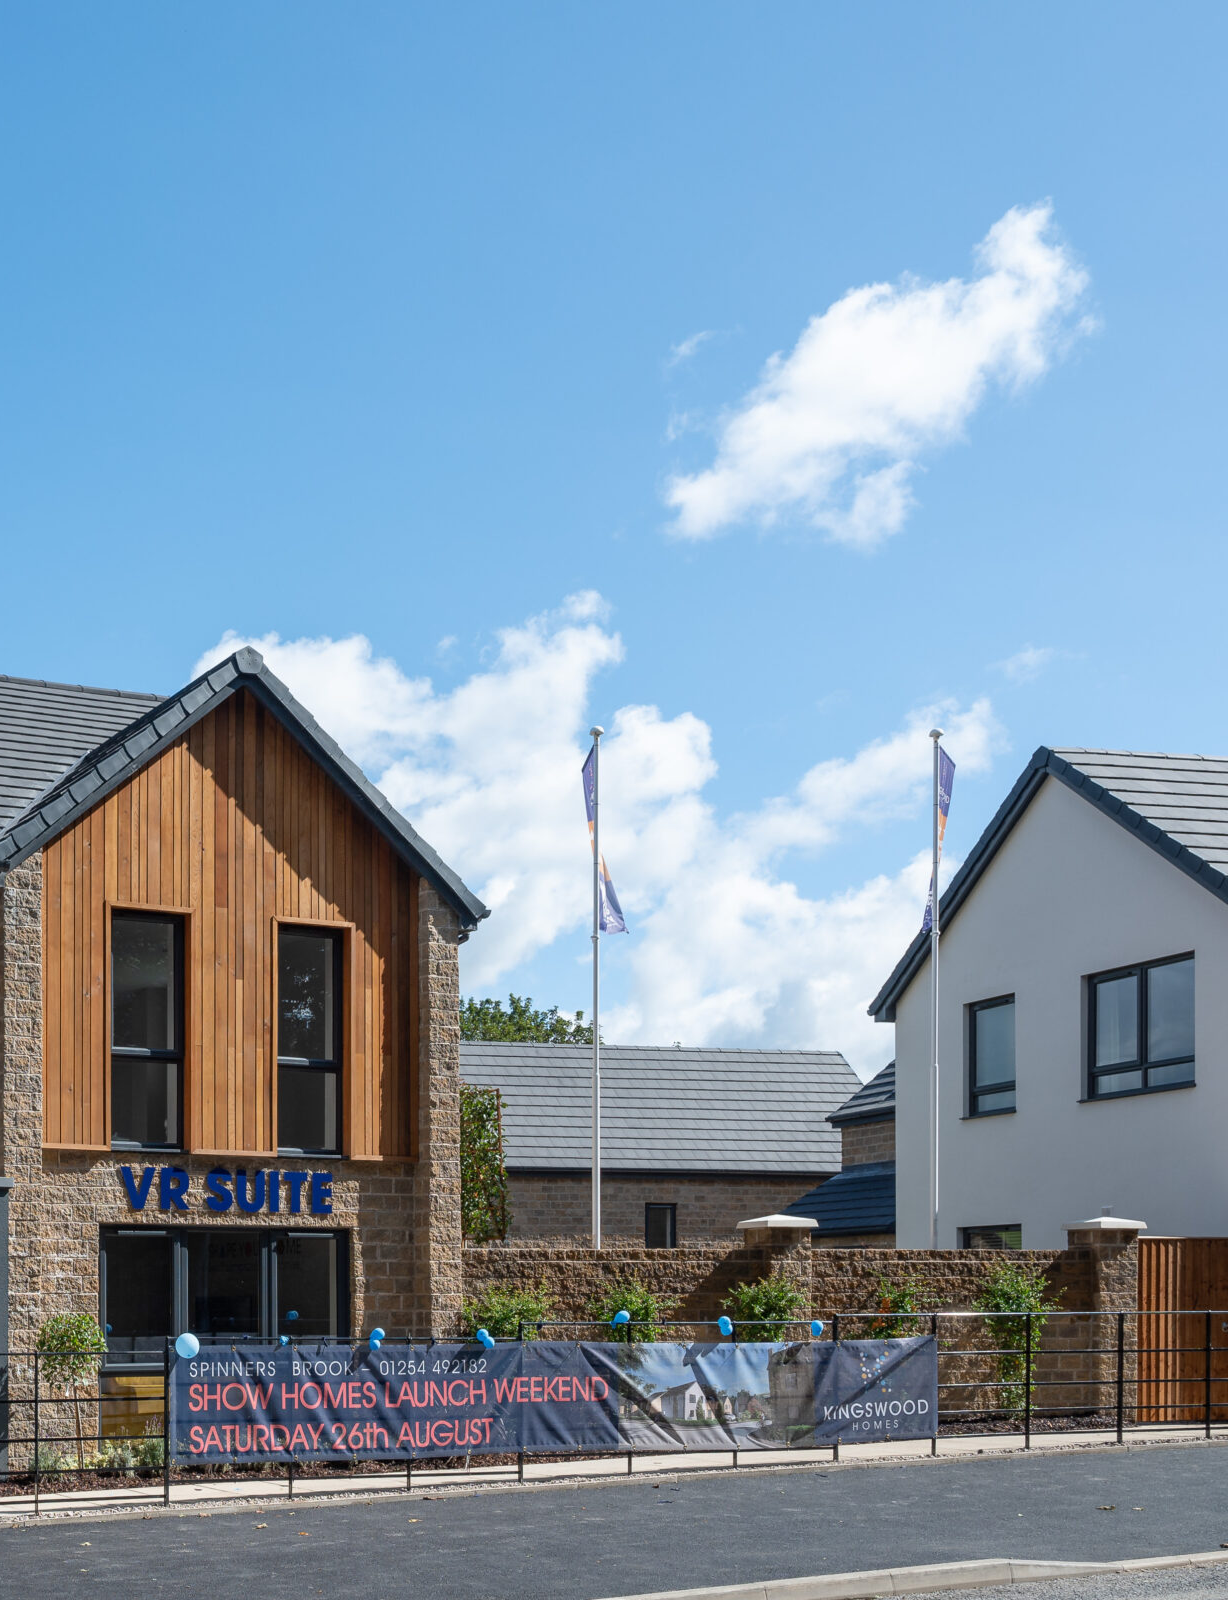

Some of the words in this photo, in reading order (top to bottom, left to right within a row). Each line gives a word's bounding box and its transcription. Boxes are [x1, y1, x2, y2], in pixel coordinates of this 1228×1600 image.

[120, 1166, 190, 1210] VR
[206, 1166, 333, 1214] SUITE
[189, 1361, 276, 1378] SPINNERS
[292, 1360, 354, 1376] BROOK
[379, 1360, 426, 1376] 01254
[432, 1358, 487, 1375] 492182
[188, 1382, 274, 1412] SHOW
[281, 1381, 377, 1410] HOMES
[384, 1378, 487, 1408] LAUNCH
[493, 1376, 609, 1403] WEEKEND
[823, 1399, 929, 1421] KINGSWOOD
[188, 1423, 325, 1454] SATURDAY
[331, 1422, 389, 1450] 26th
[395, 1417, 494, 1448] AUGUST
[852, 1419, 899, 1431] HOMES
